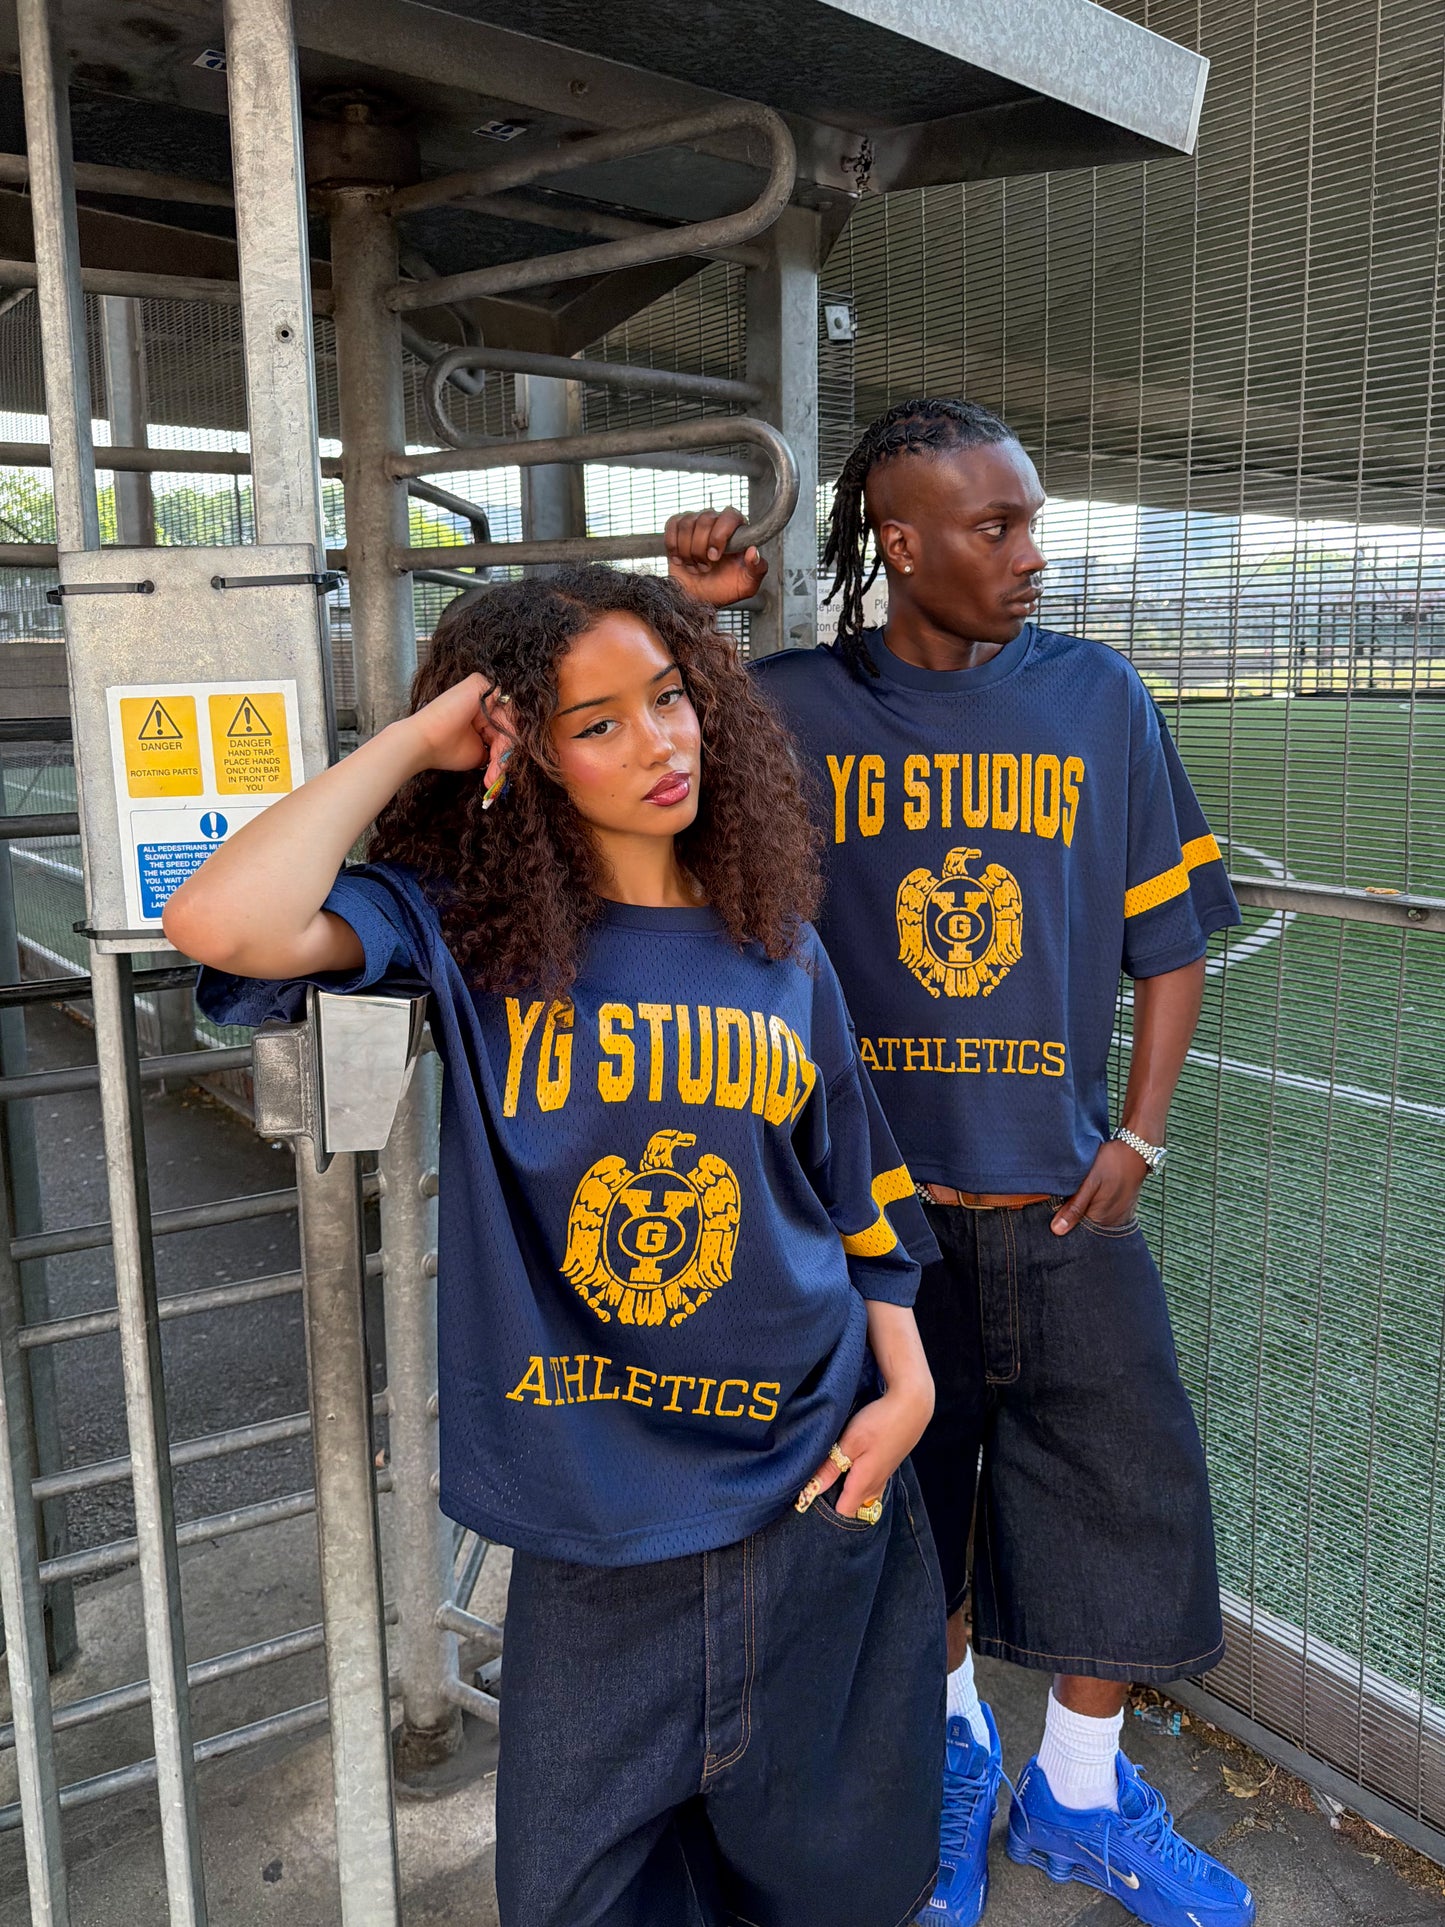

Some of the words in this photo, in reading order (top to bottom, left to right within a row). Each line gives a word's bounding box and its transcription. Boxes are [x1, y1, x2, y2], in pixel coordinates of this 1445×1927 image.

[141, 742, 183, 751] DANGER
[229, 739, 272, 748] DANGER
[224, 758, 250, 766] PLACE
[252, 757, 281, 765] HANDS
[130, 769, 171, 777] ROTATING
[172, 768, 199, 776] PARTS
[226, 767, 247, 775] ONLY
[239, 775, 266, 783] FRONT
[246, 784, 264, 792] YOU
[826, 754, 886, 844] YG
[903, 753, 1085, 848] STUDIOS
[157, 844, 208, 852] PEDESTRIANS
[144, 853, 174, 861] SLOWLY
[165, 860, 190, 868] SPEED
[503, 996, 575, 1118] YG
[860, 1036, 1066, 1077] ATHLETICS
[505, 1354, 781, 1422] ATHLETICS
